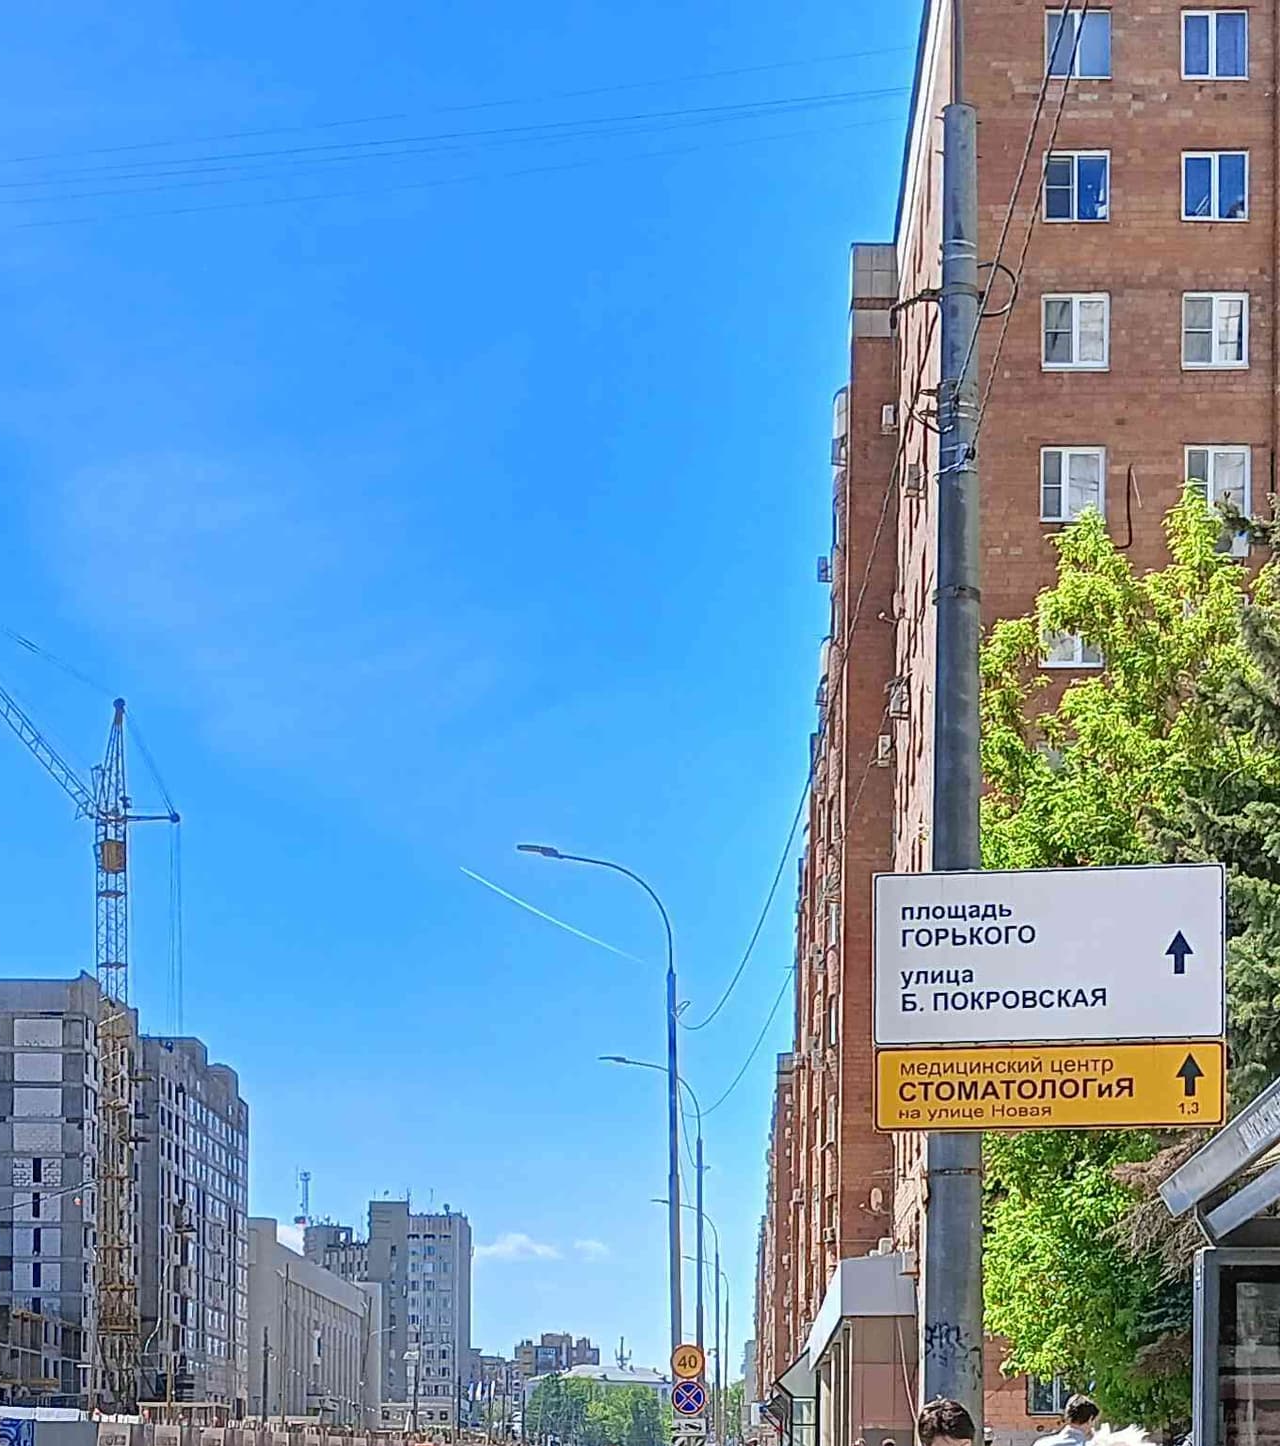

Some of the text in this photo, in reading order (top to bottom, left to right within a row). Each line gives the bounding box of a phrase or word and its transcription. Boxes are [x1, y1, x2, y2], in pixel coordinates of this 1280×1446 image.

[902, 904, 1012, 921] площадь
[902, 925, 1036, 947] ГОРЬКОГО
[900, 969, 974, 989] улица
[902, 988, 1107, 1011] Б. ПОКРОВСКАЯ
[900, 1057, 1114, 1076] медицинский центр
[899, 1104, 1052, 1121] на улице Новая
[677, 1354, 697, 1369] 40
